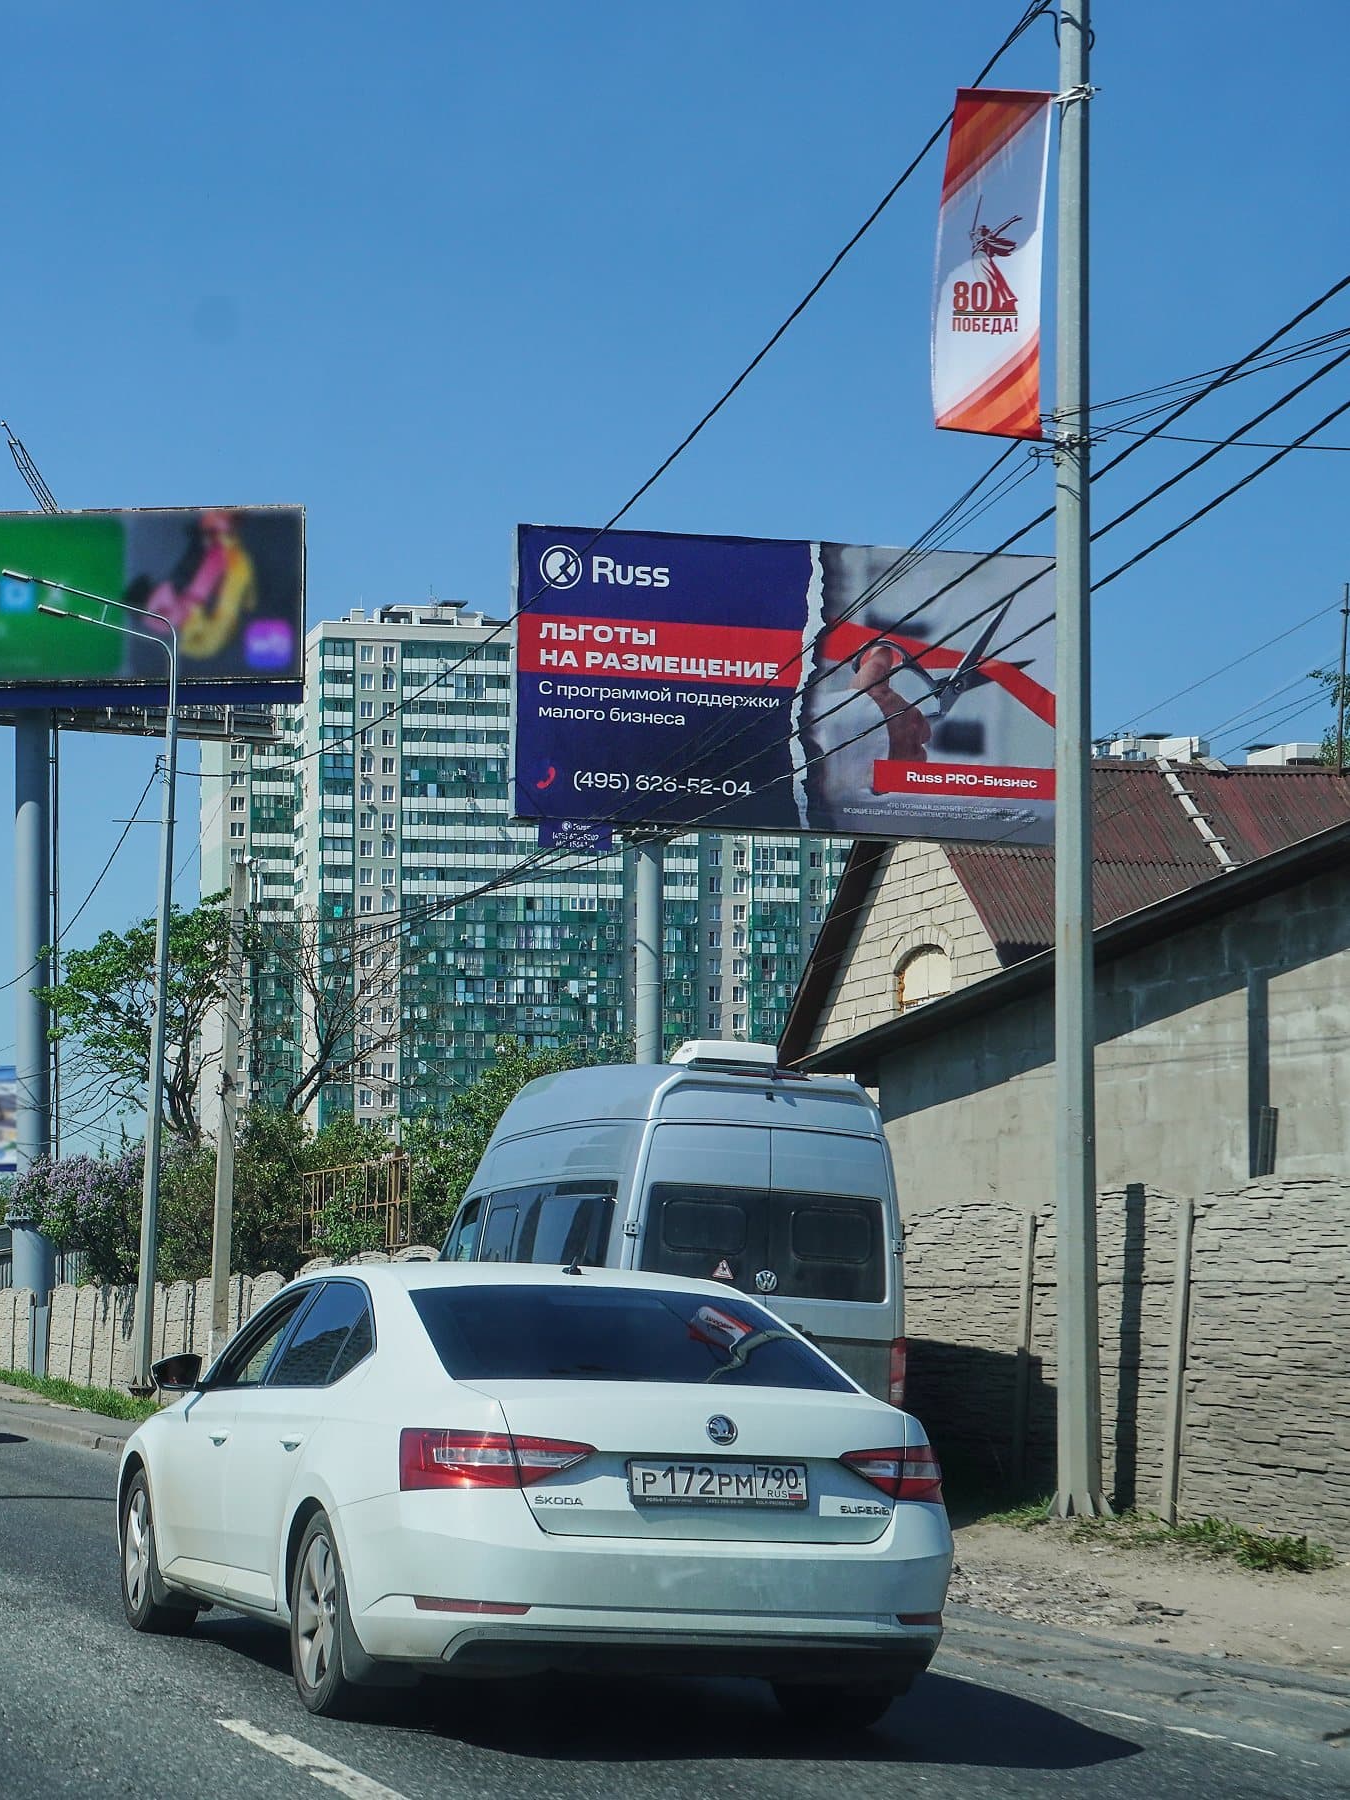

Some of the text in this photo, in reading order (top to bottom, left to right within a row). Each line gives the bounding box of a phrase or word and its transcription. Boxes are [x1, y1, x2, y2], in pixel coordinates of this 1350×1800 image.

[953, 281, 988, 311] 80
[952, 317, 1018, 335] ПОБЕДА!
[592, 555, 670, 588] Russ
[539, 622, 656, 646] ЛЬГОТЫ
[539, 648, 779, 680] НА РАЗМЕЩЕНИЕ
[538, 680, 780, 709] С программой поддержки
[538, 706, 686, 726] малого бизнеса
[573, 769, 752, 797] (495) 626-52-04
[906, 771, 1038, 789] Russ PRO-Бизнес
[757, 1466, 799, 1490] 790
[534, 1495, 584, 1506] ŠKODA
[767, 1489, 788, 1499] RUS
[840, 1505, 890, 1516] SUPERB
